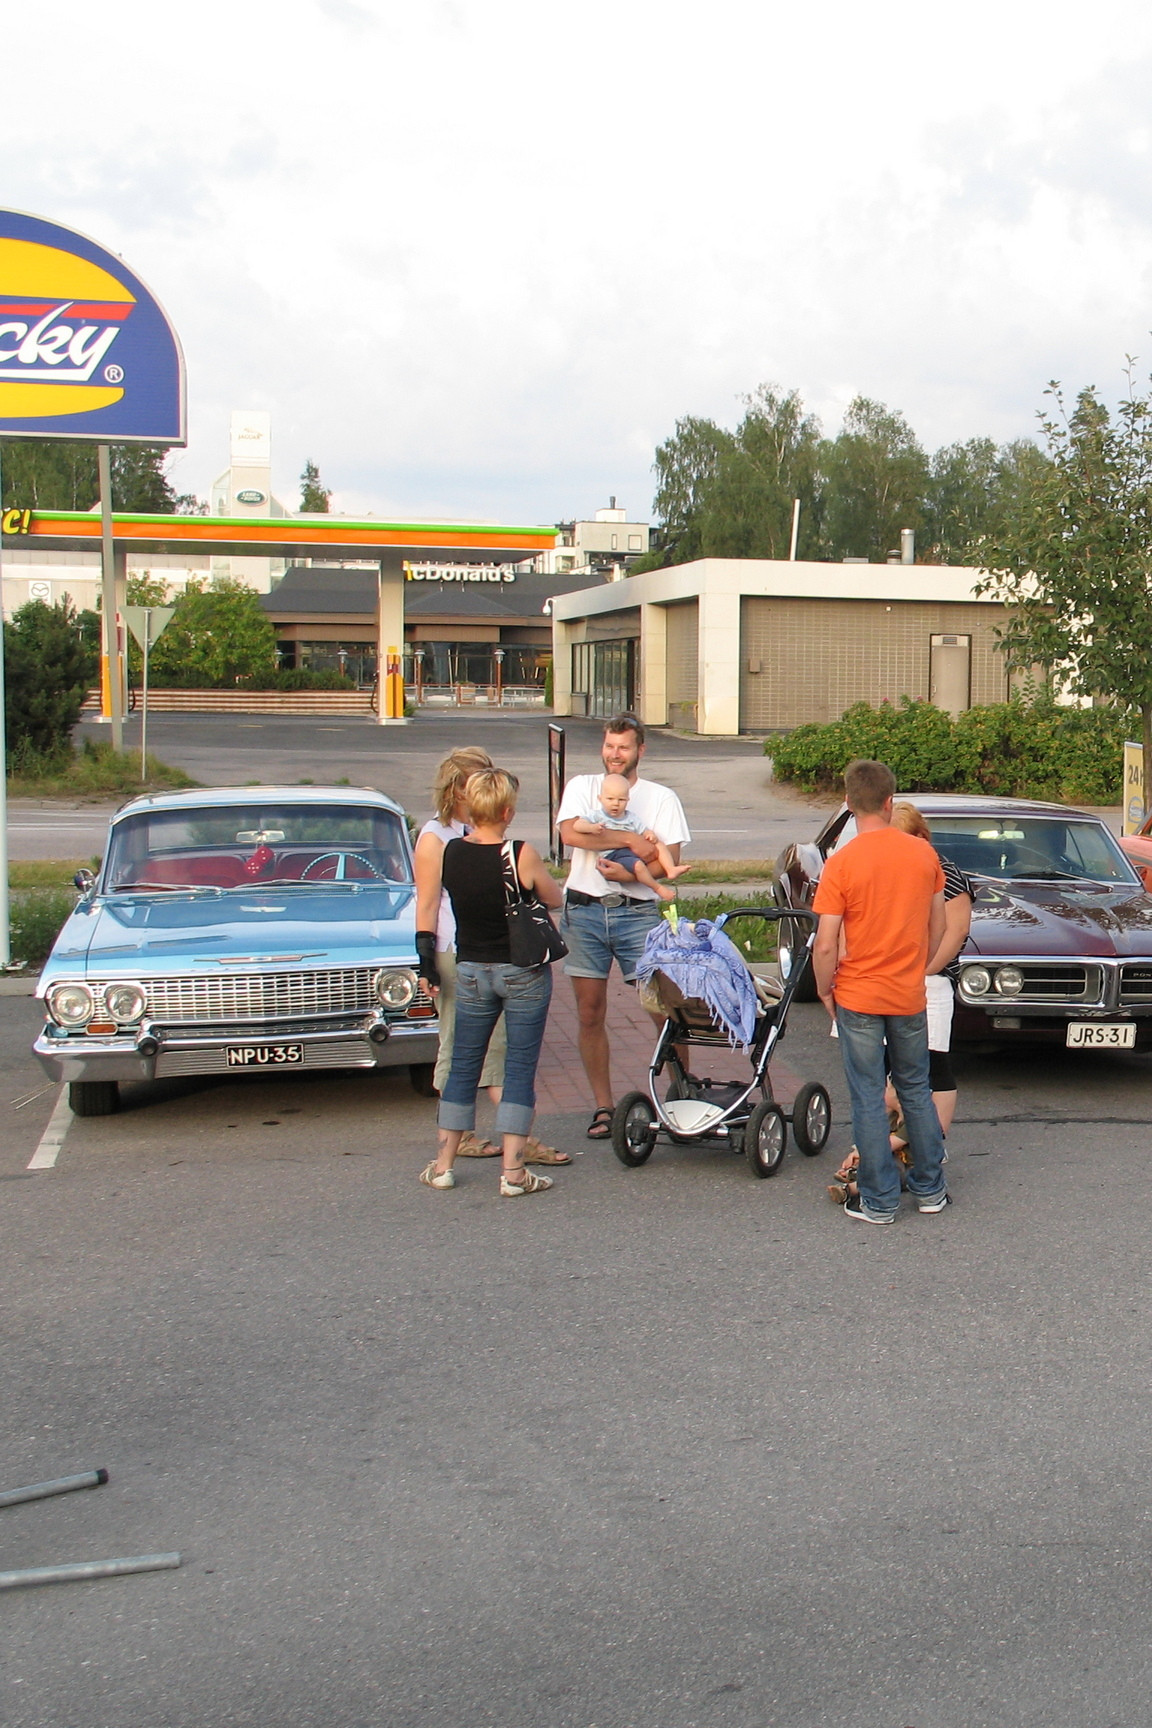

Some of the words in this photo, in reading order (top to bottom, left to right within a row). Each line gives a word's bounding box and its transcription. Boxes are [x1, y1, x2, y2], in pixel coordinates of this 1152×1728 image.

[1, 508, 31, 534] C!
[1073, 1028, 1128, 1043] JRS-31
[230, 1046, 300, 1065] NPU-35
